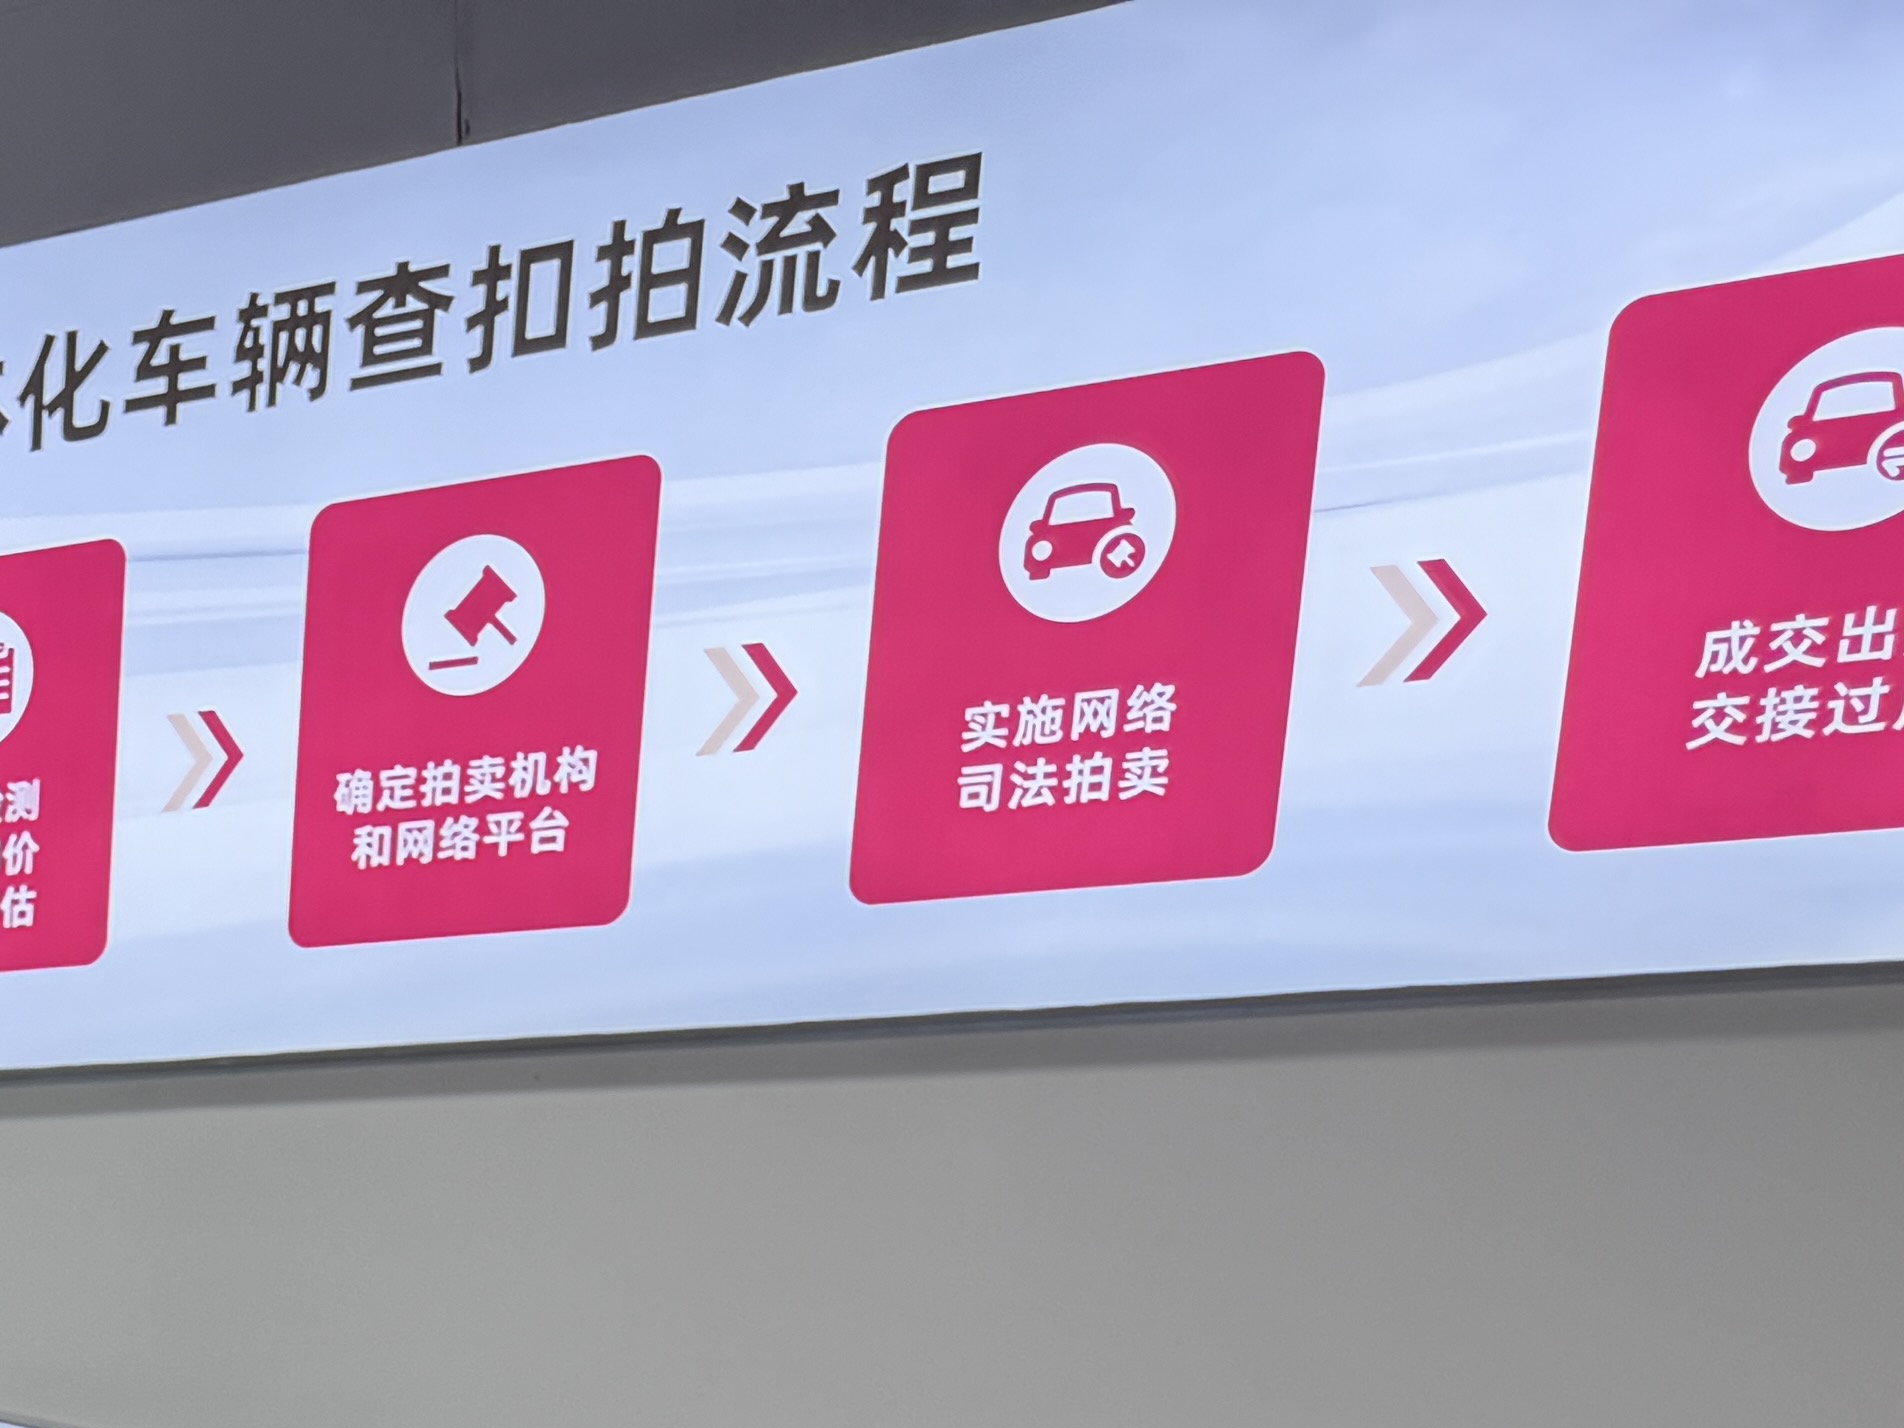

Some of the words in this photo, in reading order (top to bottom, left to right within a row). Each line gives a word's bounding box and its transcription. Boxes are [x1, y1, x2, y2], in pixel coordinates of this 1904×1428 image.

[1695, 604, 1903, 678] 成交出
[960, 682, 1177, 753] 实施网络
[1685, 676, 1903, 750] 交接过
[333, 744, 598, 816] 确定拍卖机构
[956, 746, 1169, 813] 司法拍卖
[351, 806, 570, 870] 和网络平台
